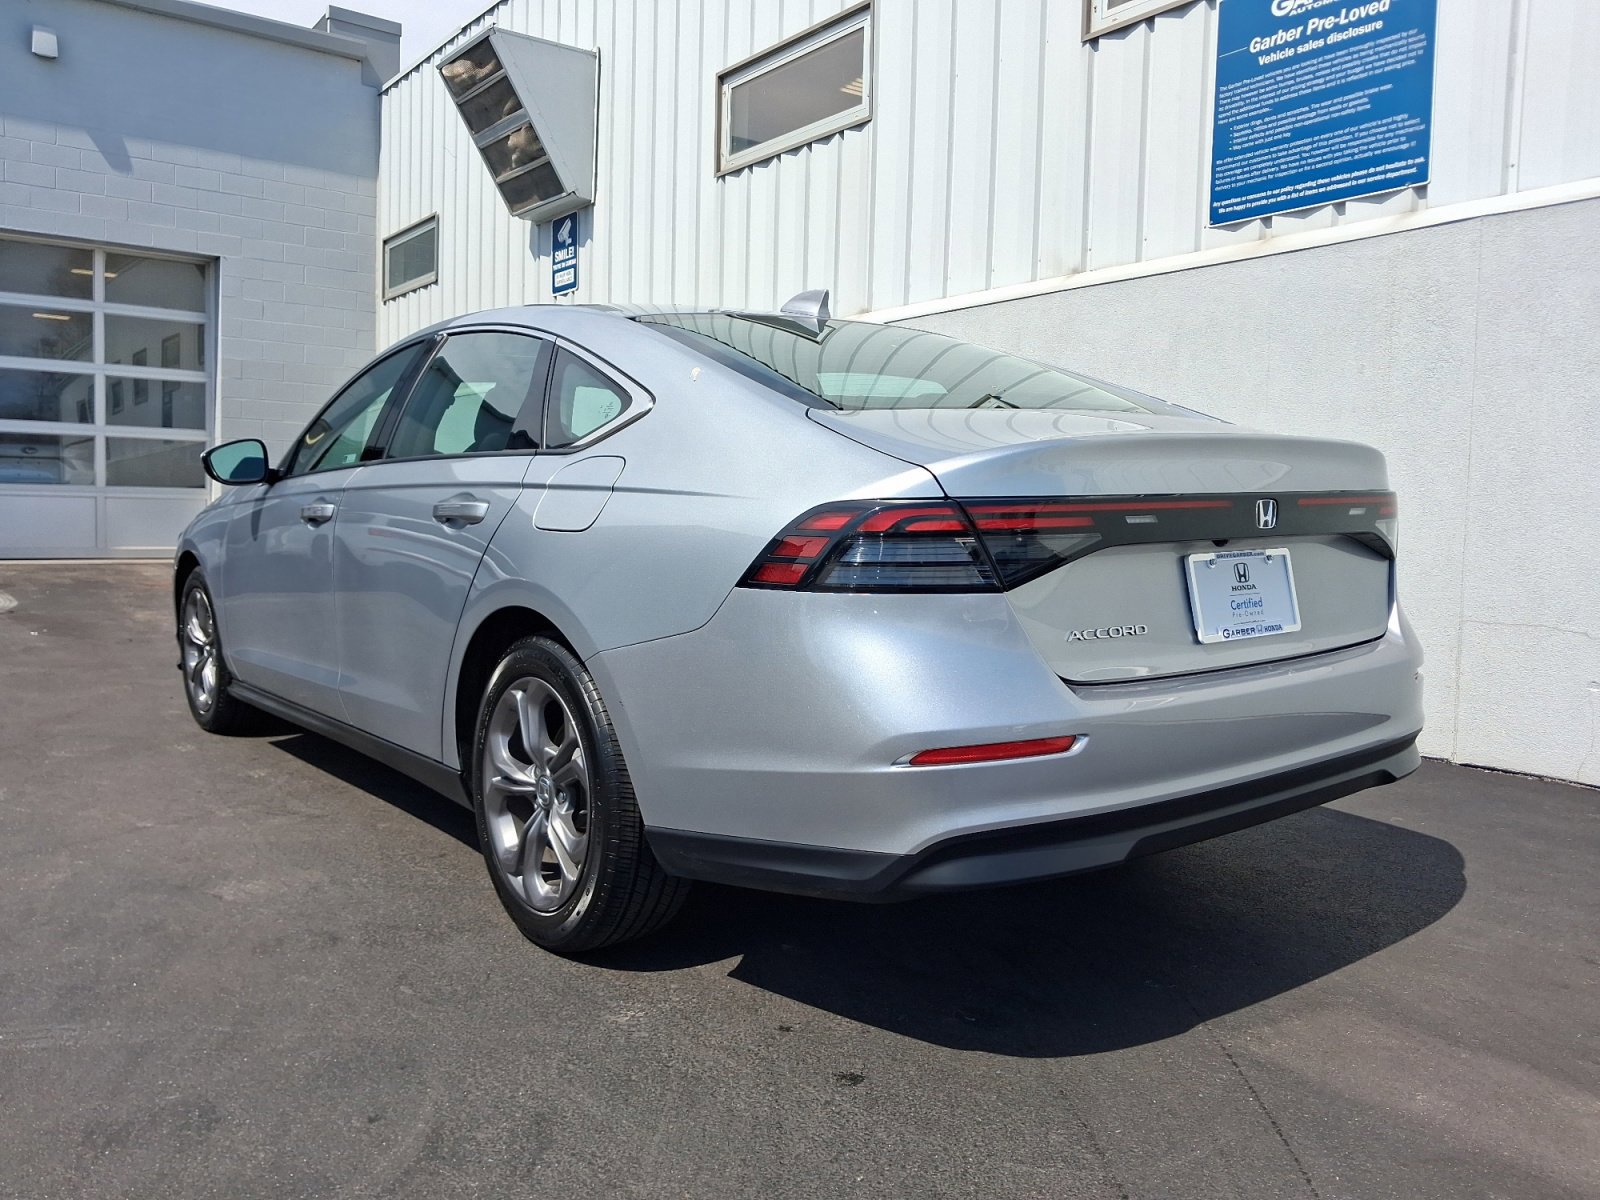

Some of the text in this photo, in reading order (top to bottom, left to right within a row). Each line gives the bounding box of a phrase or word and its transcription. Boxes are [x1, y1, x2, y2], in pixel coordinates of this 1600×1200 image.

[1249, 25, 1303, 53] Garber
[1306, 0, 1391, 35] Pre-Loved
[1258, 20, 1383, 66] Vehicle sales disclosure
[1231, 583, 1257, 592] HONDA
[1230, 597, 1263, 611] Certified
[1065, 624, 1148, 642] ACCORD
[1222, 624, 1283, 639] GARBER HONDA
